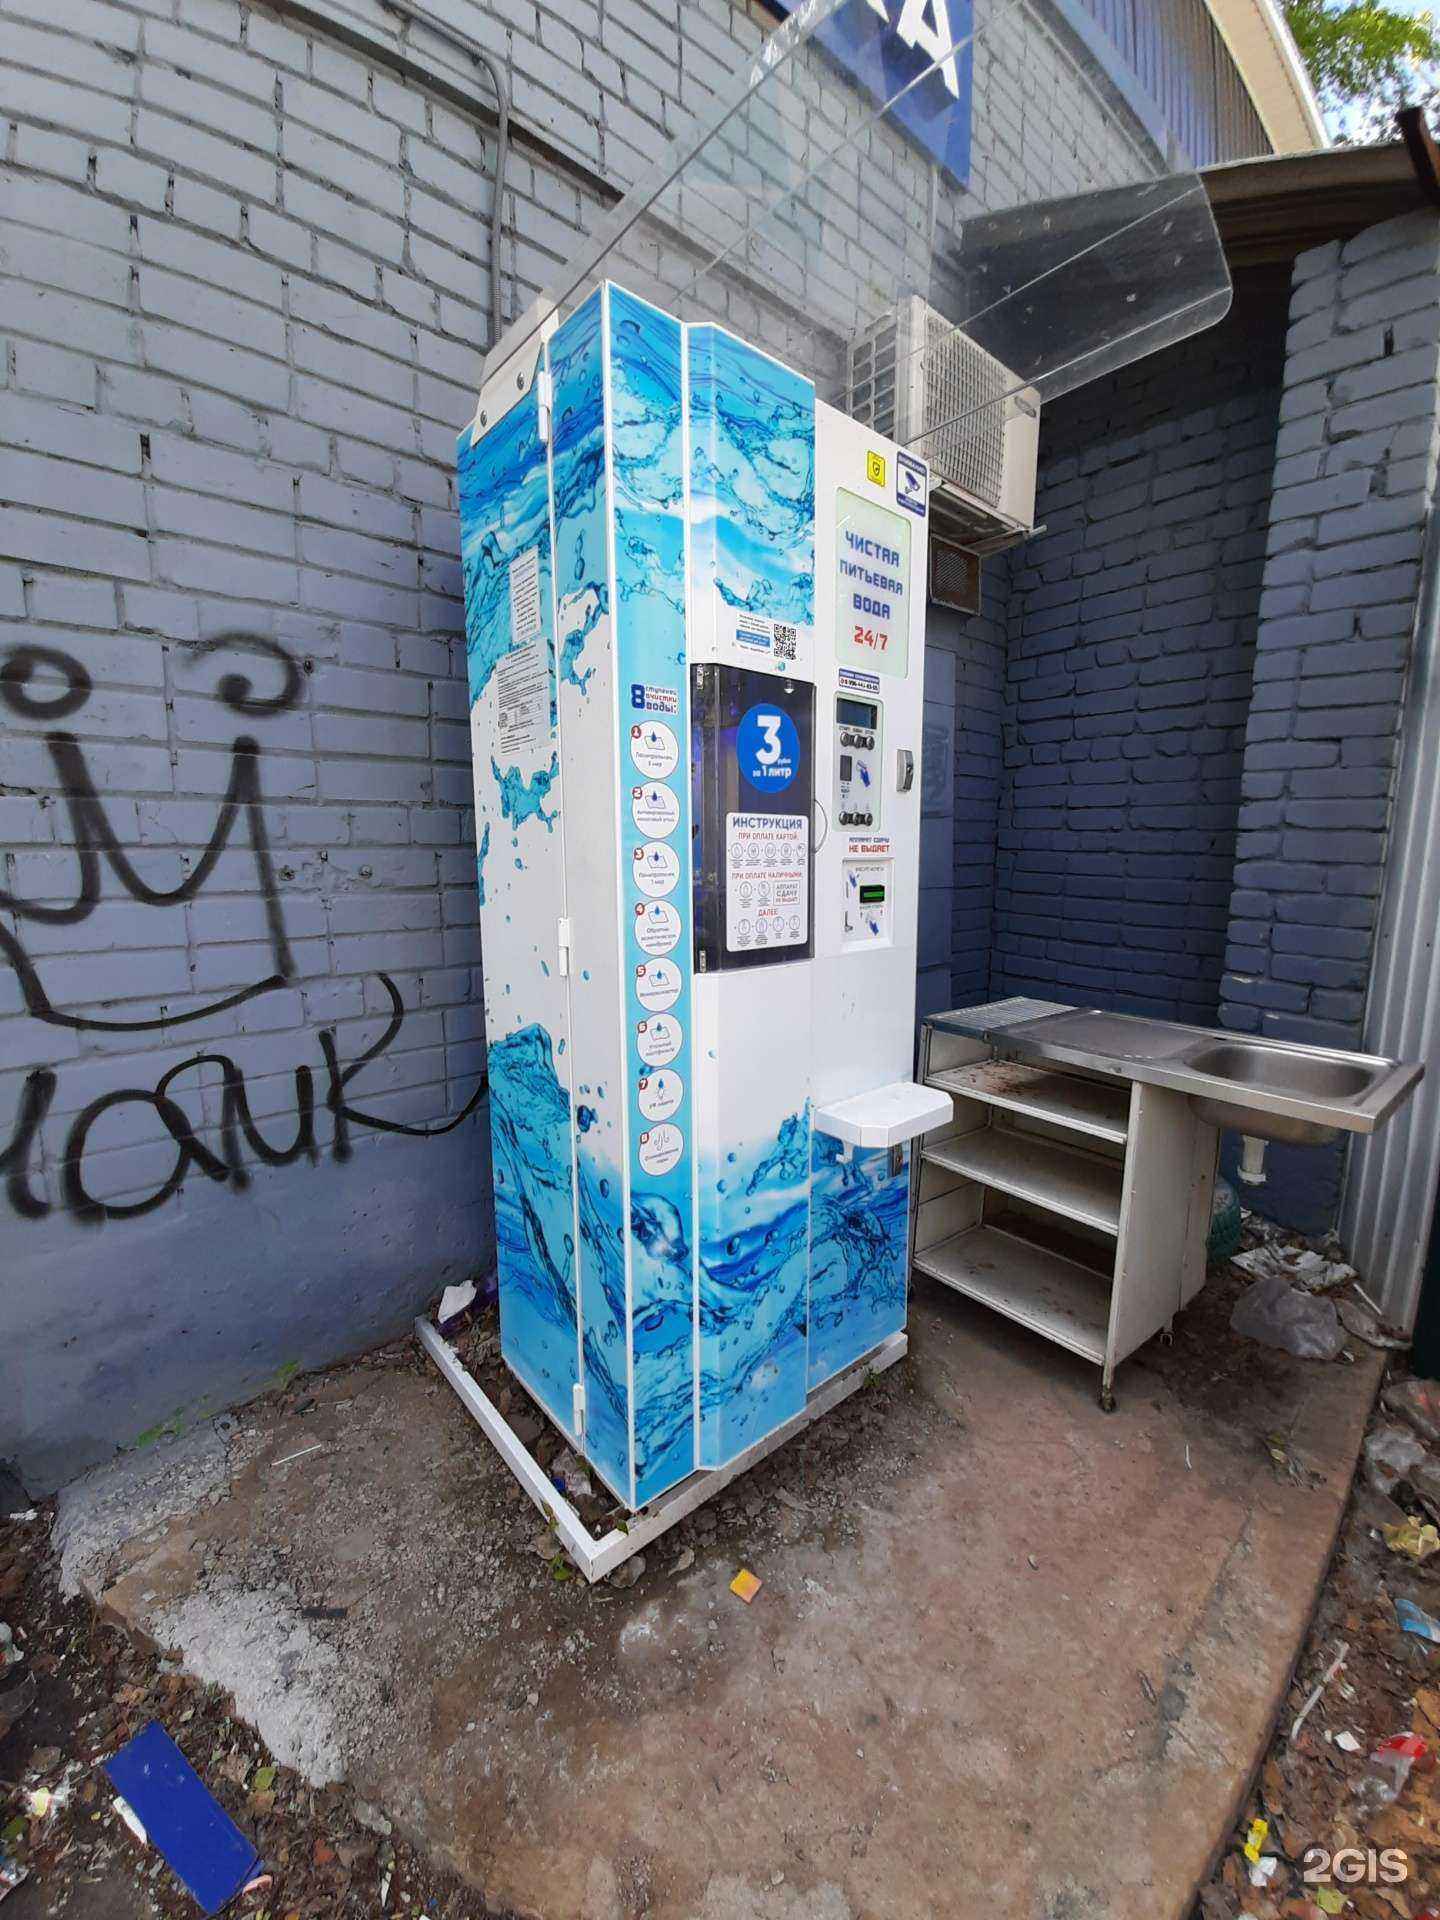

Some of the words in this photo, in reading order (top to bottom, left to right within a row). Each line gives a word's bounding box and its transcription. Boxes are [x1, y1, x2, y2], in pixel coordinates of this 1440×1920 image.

[845, 530, 900, 568] ЧИСТАЯ
[839, 559, 903, 596] ПИТЬЕВАЯ
[853, 593, 891, 620] ВОДА
[854, 625, 888, 650] 24/7
[631, 684, 645, 709] 8
[645, 692, 677, 703] очистки
[756, 715, 781, 765] 3
[761, 765, 767, 777] 1
[768, 767, 792, 779] литр
[732, 816, 803, 831] ИНСТРУКЦИЯ
[738, 832, 751, 840] ПРИ
[752, 832, 774, 841] ОПЛАТЕ
